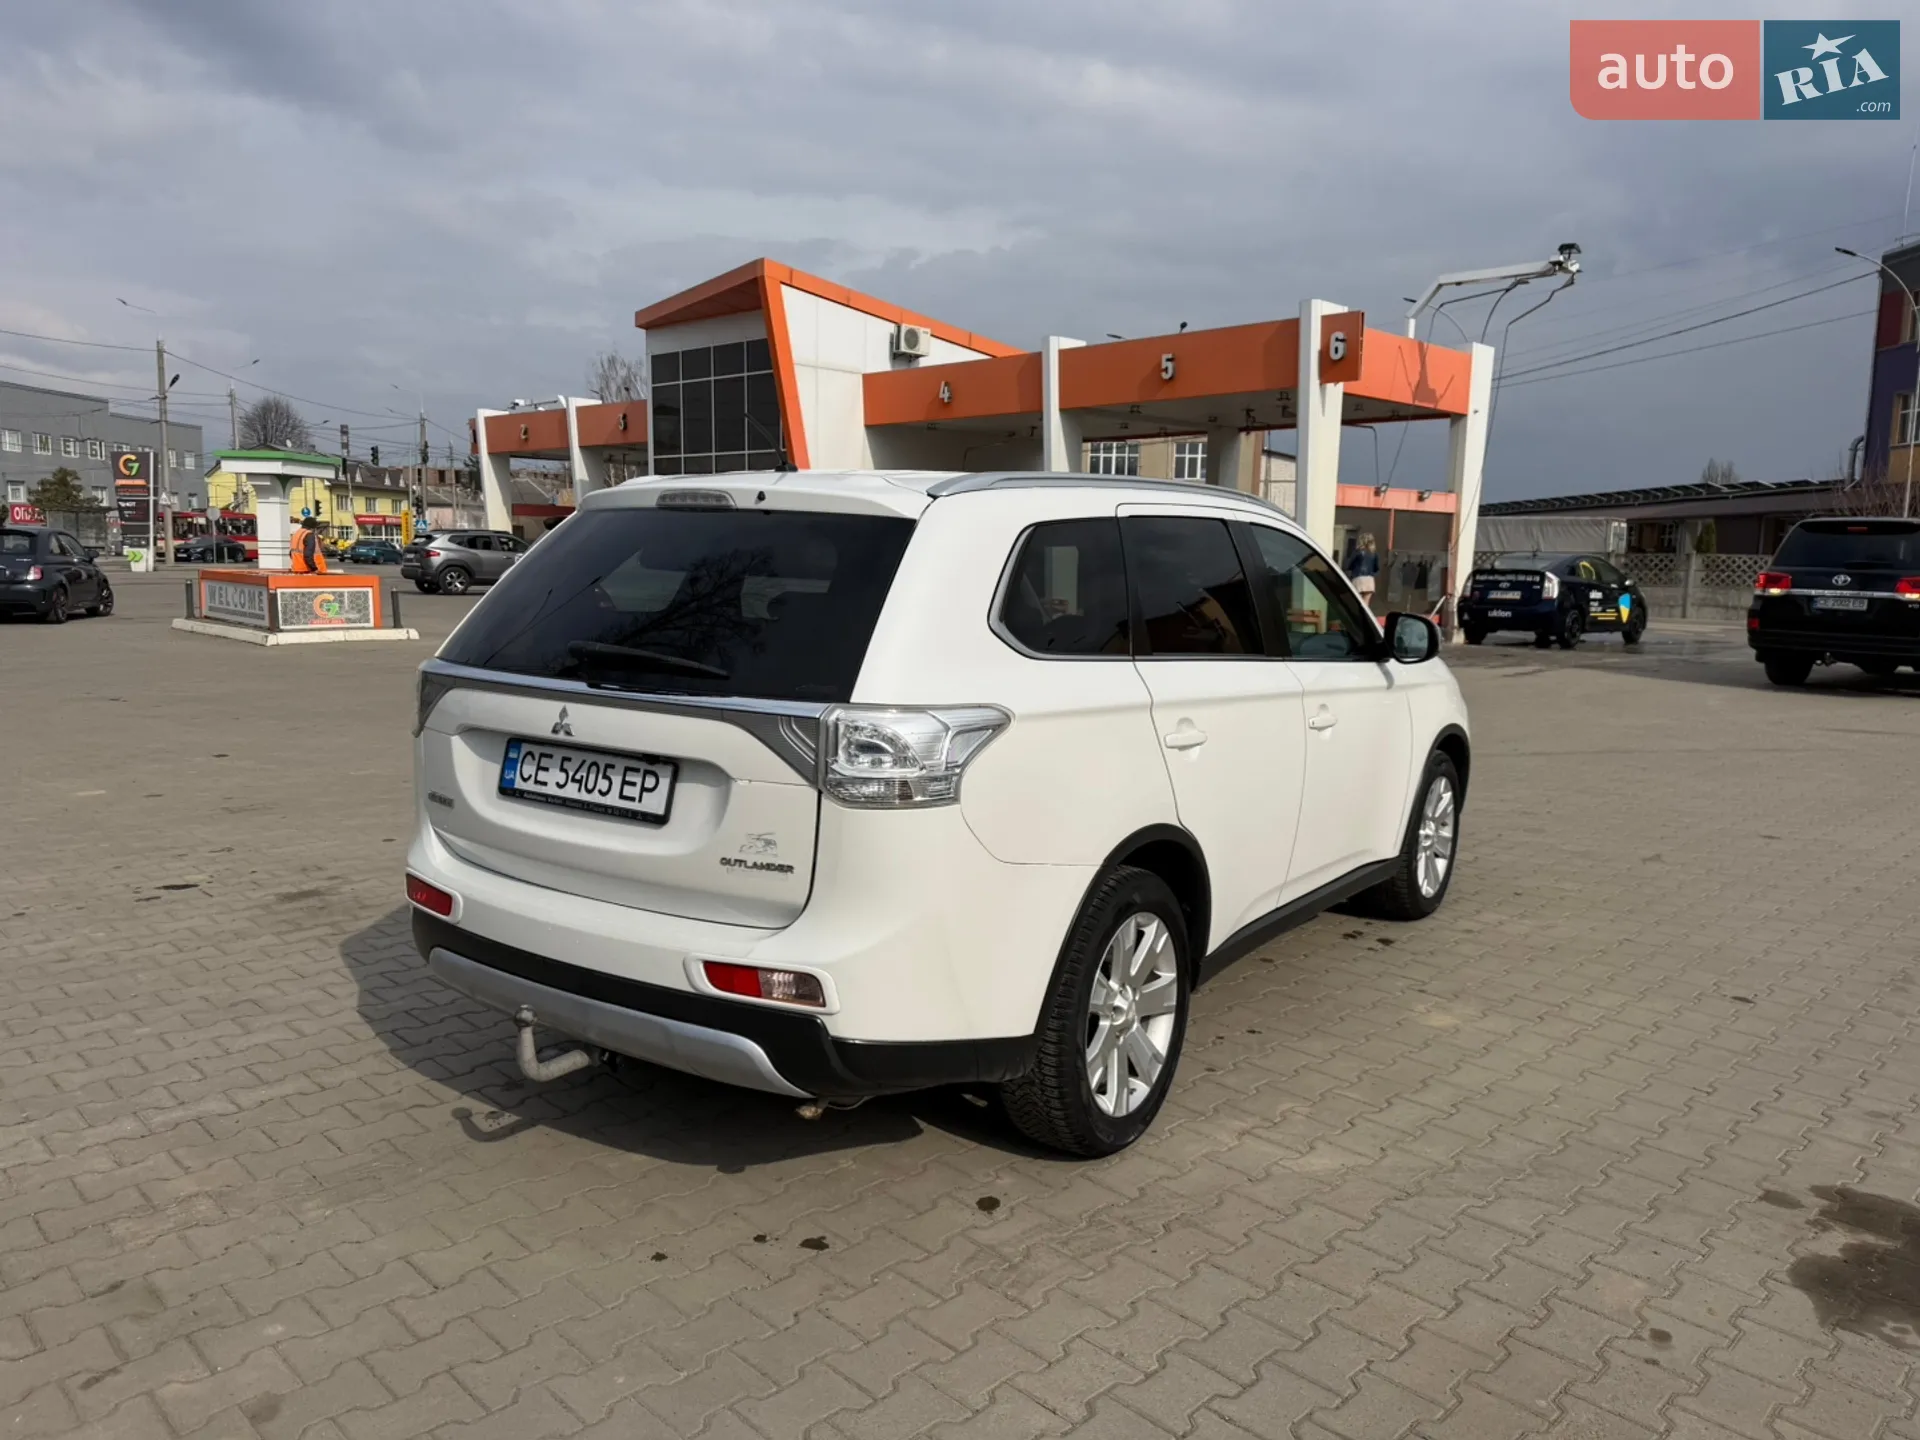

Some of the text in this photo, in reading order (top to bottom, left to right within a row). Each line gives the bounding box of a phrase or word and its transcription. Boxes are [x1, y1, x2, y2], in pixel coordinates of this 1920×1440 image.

[1329, 331, 1346, 360] 6
[1160, 353, 1175, 380] 5
[939, 380, 951, 403] 4
[207, 584, 265, 613] WELCOME
[503, 771, 515, 780] UA
[519, 750, 660, 804] CE 5405 EP
[720, 856, 794, 875] OUTLANDER
